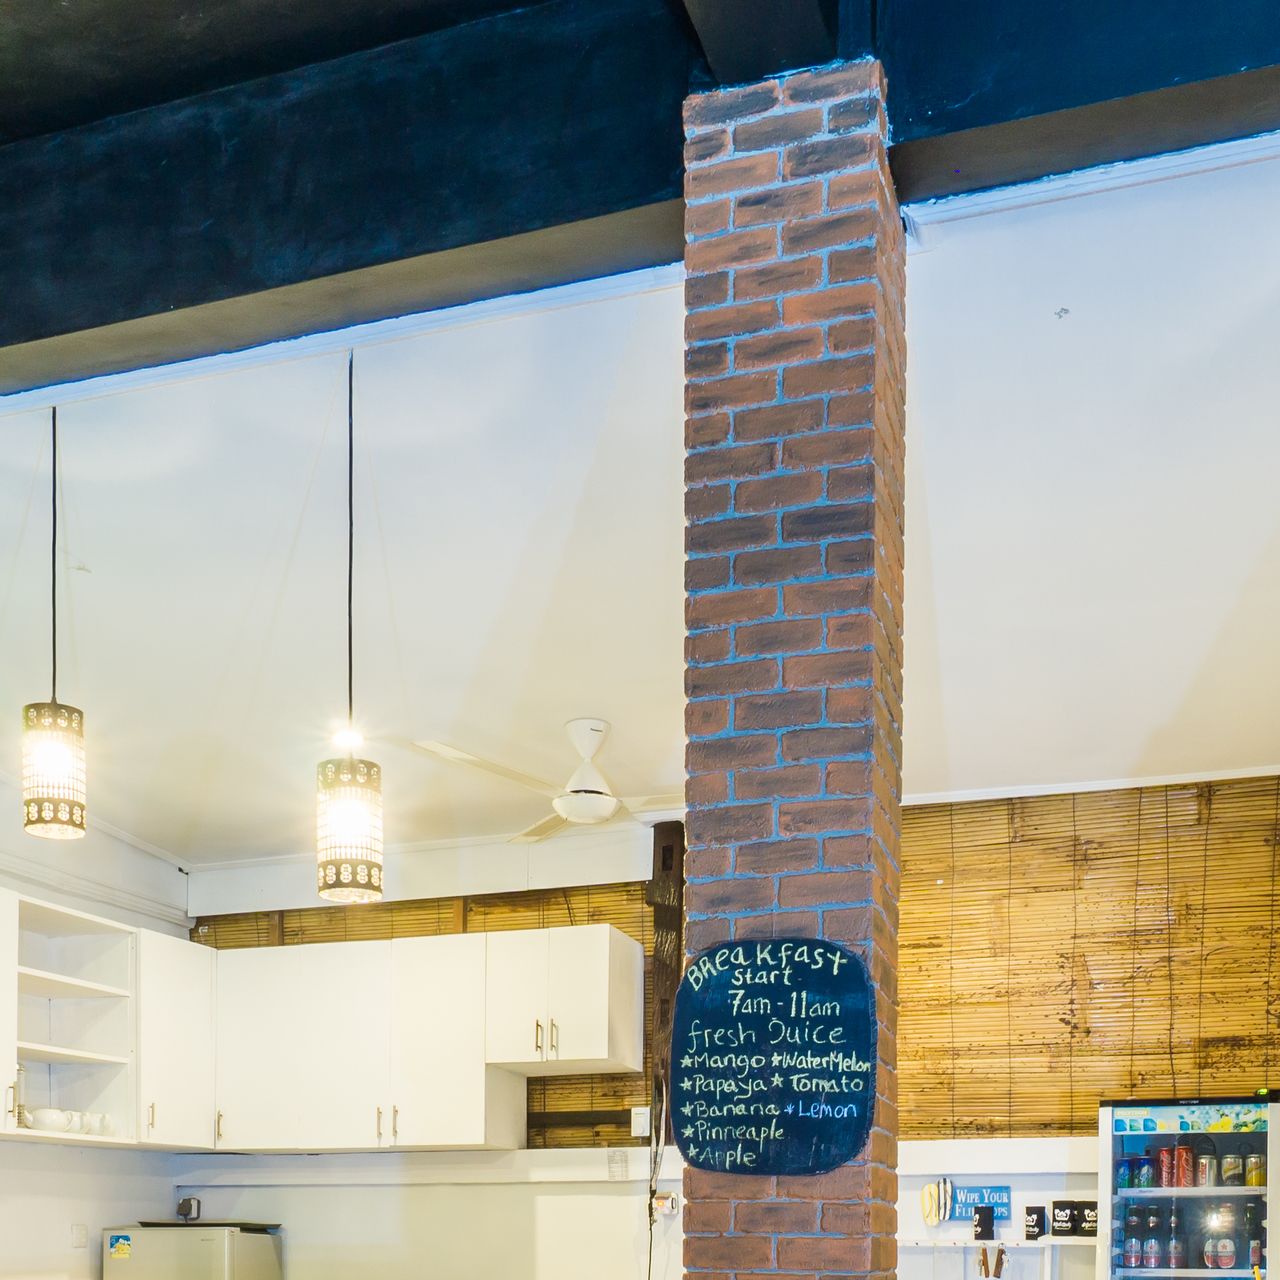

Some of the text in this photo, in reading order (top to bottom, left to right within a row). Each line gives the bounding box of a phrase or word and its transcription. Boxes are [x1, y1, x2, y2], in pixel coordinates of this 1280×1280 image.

[728, 989, 771, 1016] 7am
[790, 991, 840, 1018] 11am
[768, 1018, 846, 1044] Juice
[694, 1055, 766, 1078] Mango
[694, 1073, 864, 1101] Papaya Tomato
[696, 1100, 857, 1118] Banana Lemon
[694, 1119, 785, 1150] Pinneaple
